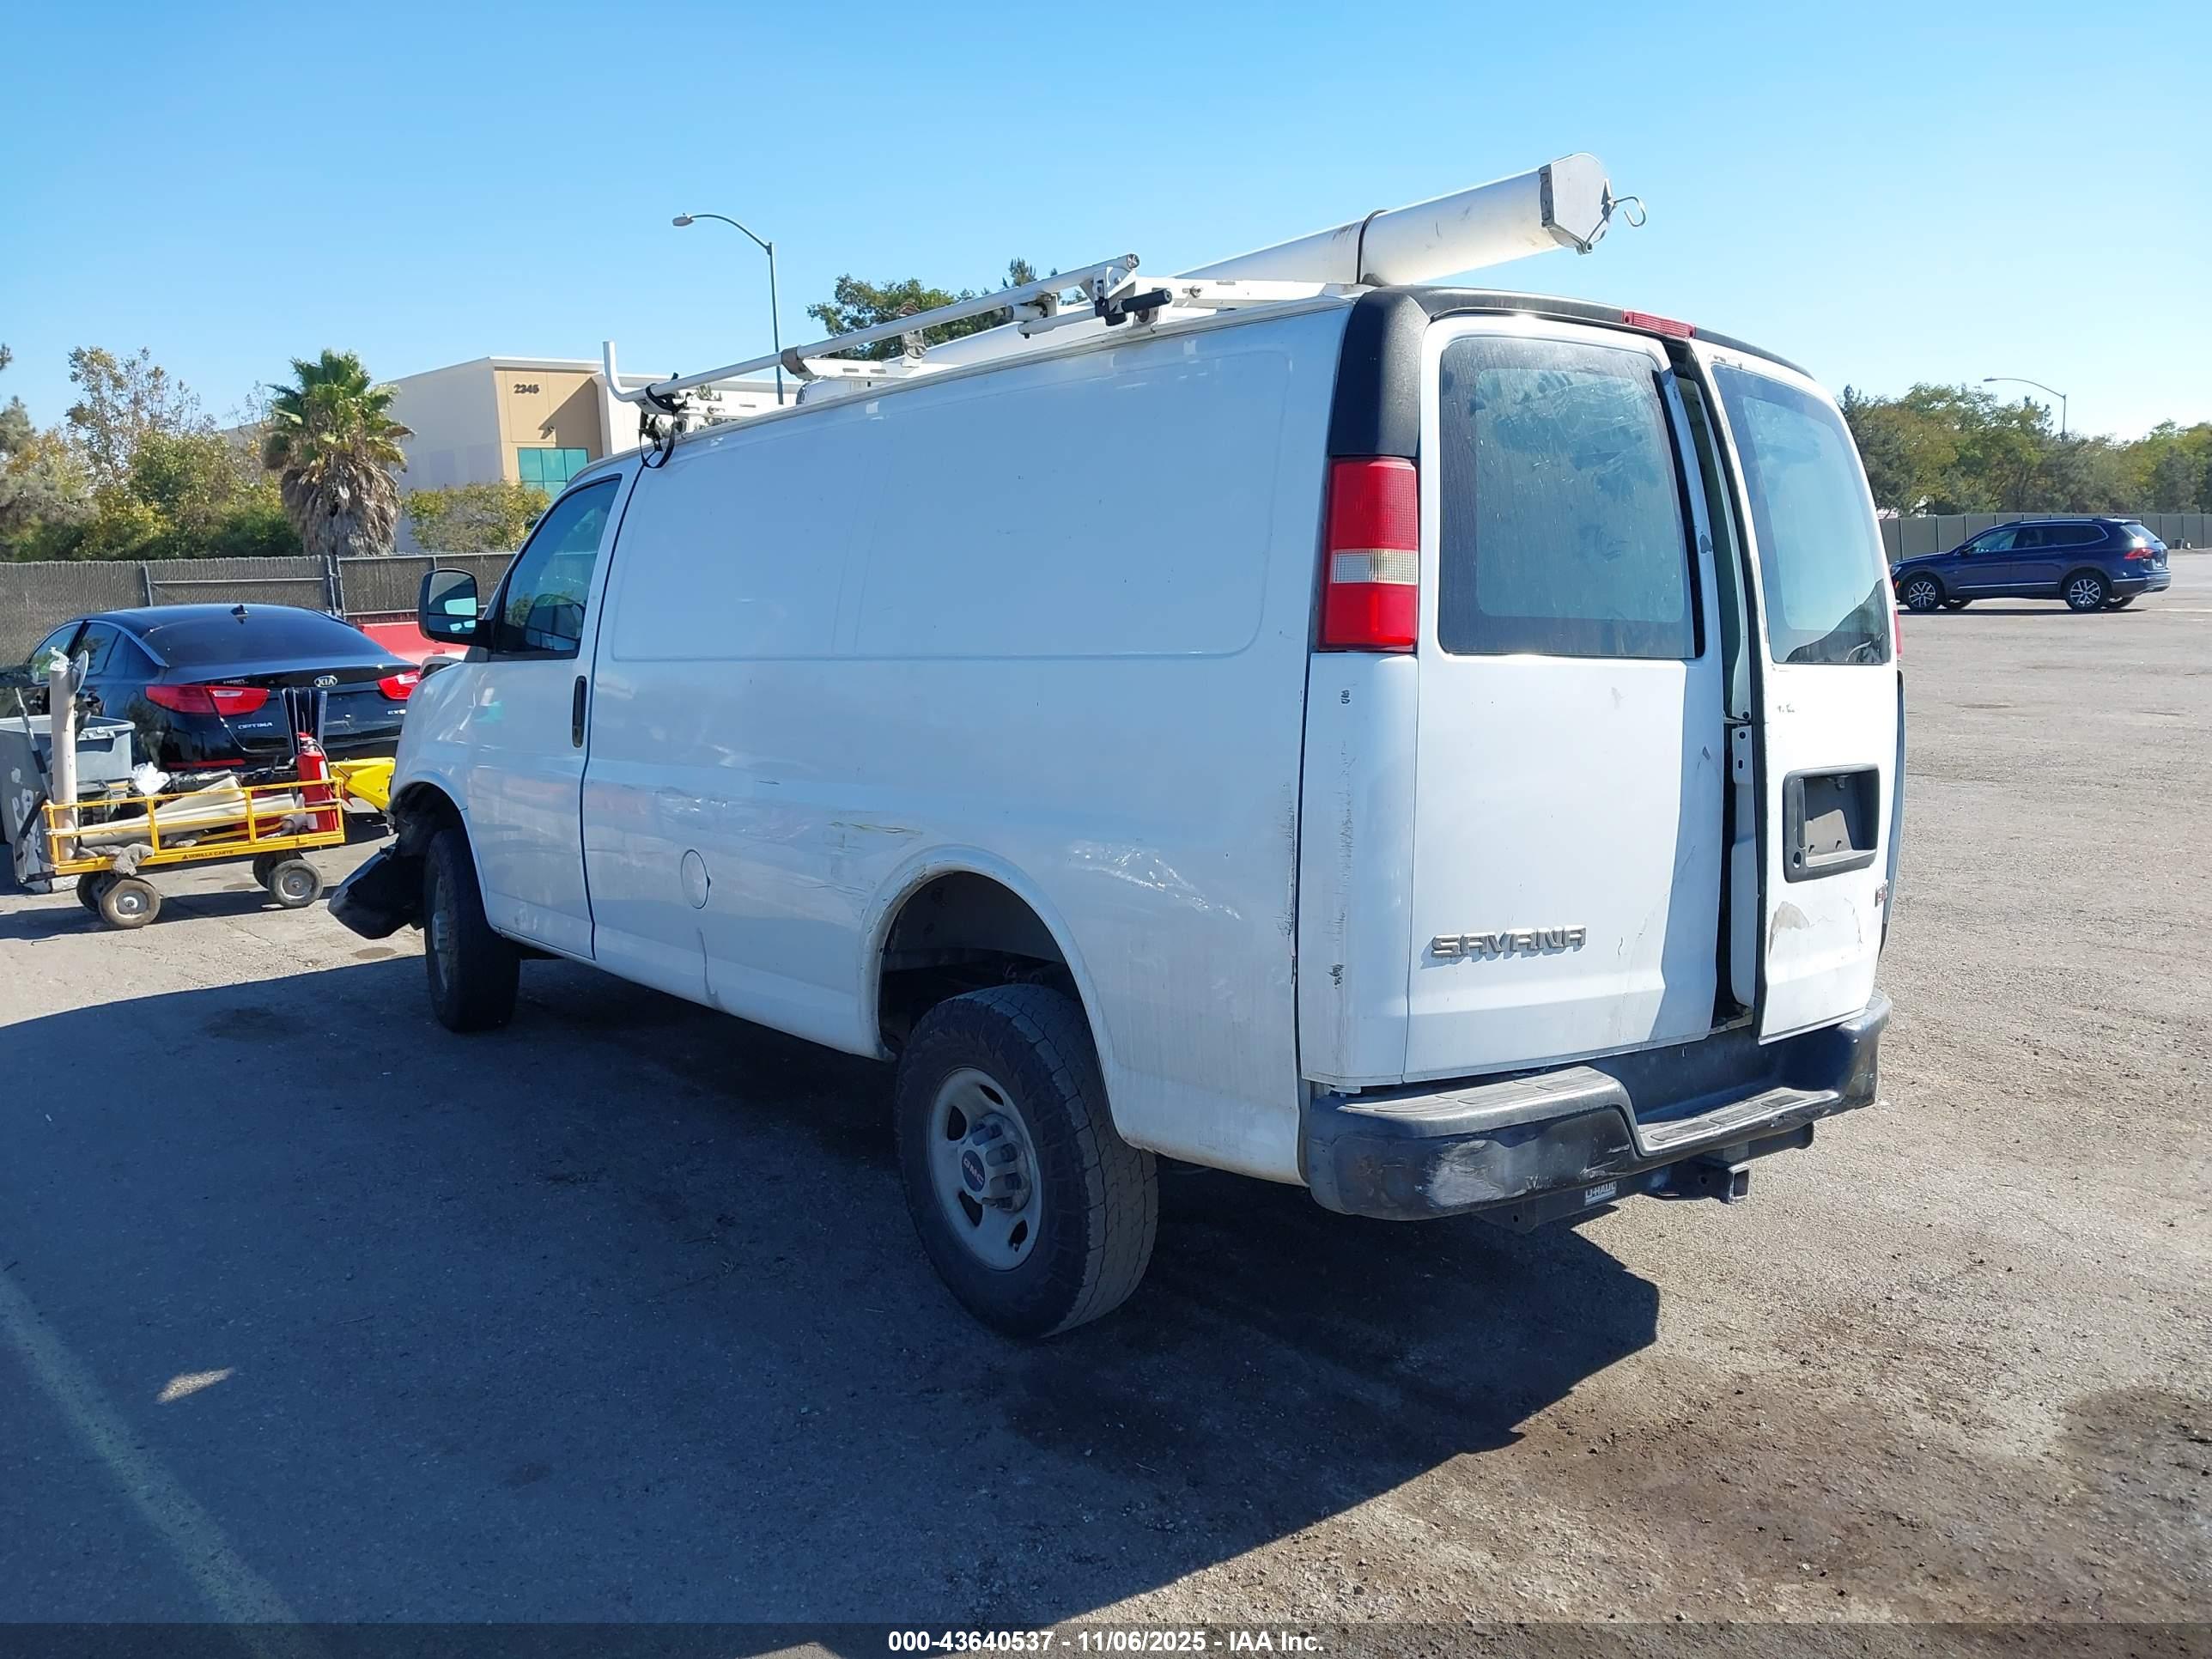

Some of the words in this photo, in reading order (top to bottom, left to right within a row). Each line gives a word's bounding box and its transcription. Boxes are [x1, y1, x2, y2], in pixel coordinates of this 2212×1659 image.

[514, 384, 539, 393] 2345
[317, 677, 336, 687] KIA
[1431, 925, 1586, 957] SAVANA
[963, 1158, 984, 1186] GMC
